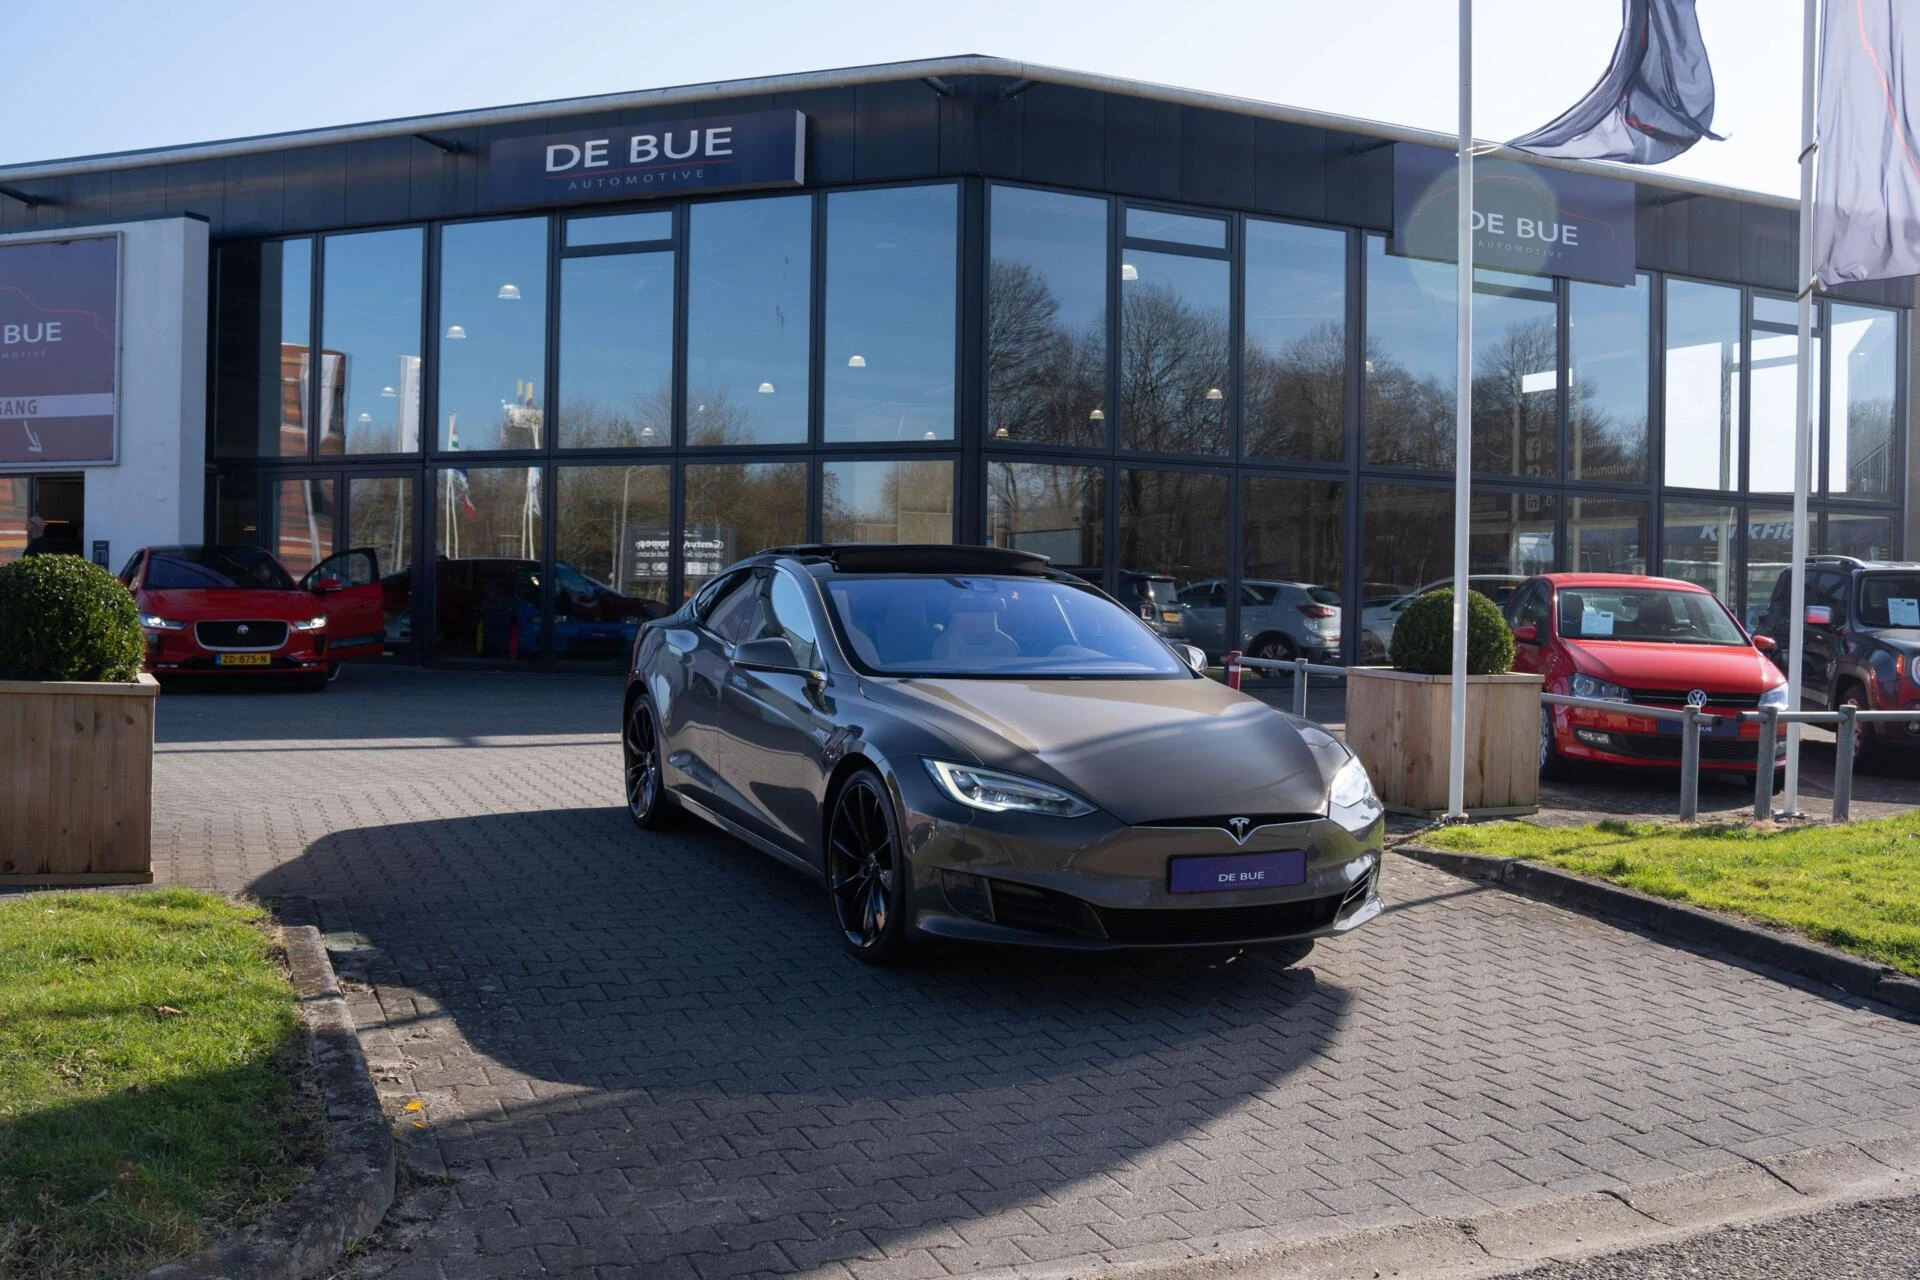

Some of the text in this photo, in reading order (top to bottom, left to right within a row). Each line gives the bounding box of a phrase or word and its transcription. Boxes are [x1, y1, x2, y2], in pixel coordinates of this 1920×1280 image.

[545, 127, 732, 172] DE BUE
[568, 169, 705, 191] AUTOMOTIVE
[1516, 217, 1578, 246] BUE
[1478, 239, 1563, 259] AUTOMOTIVE
[4, 322, 62, 344] BUE
[0, 399, 37, 416] ANG
[1218, 871, 1265, 882] DE BUE
